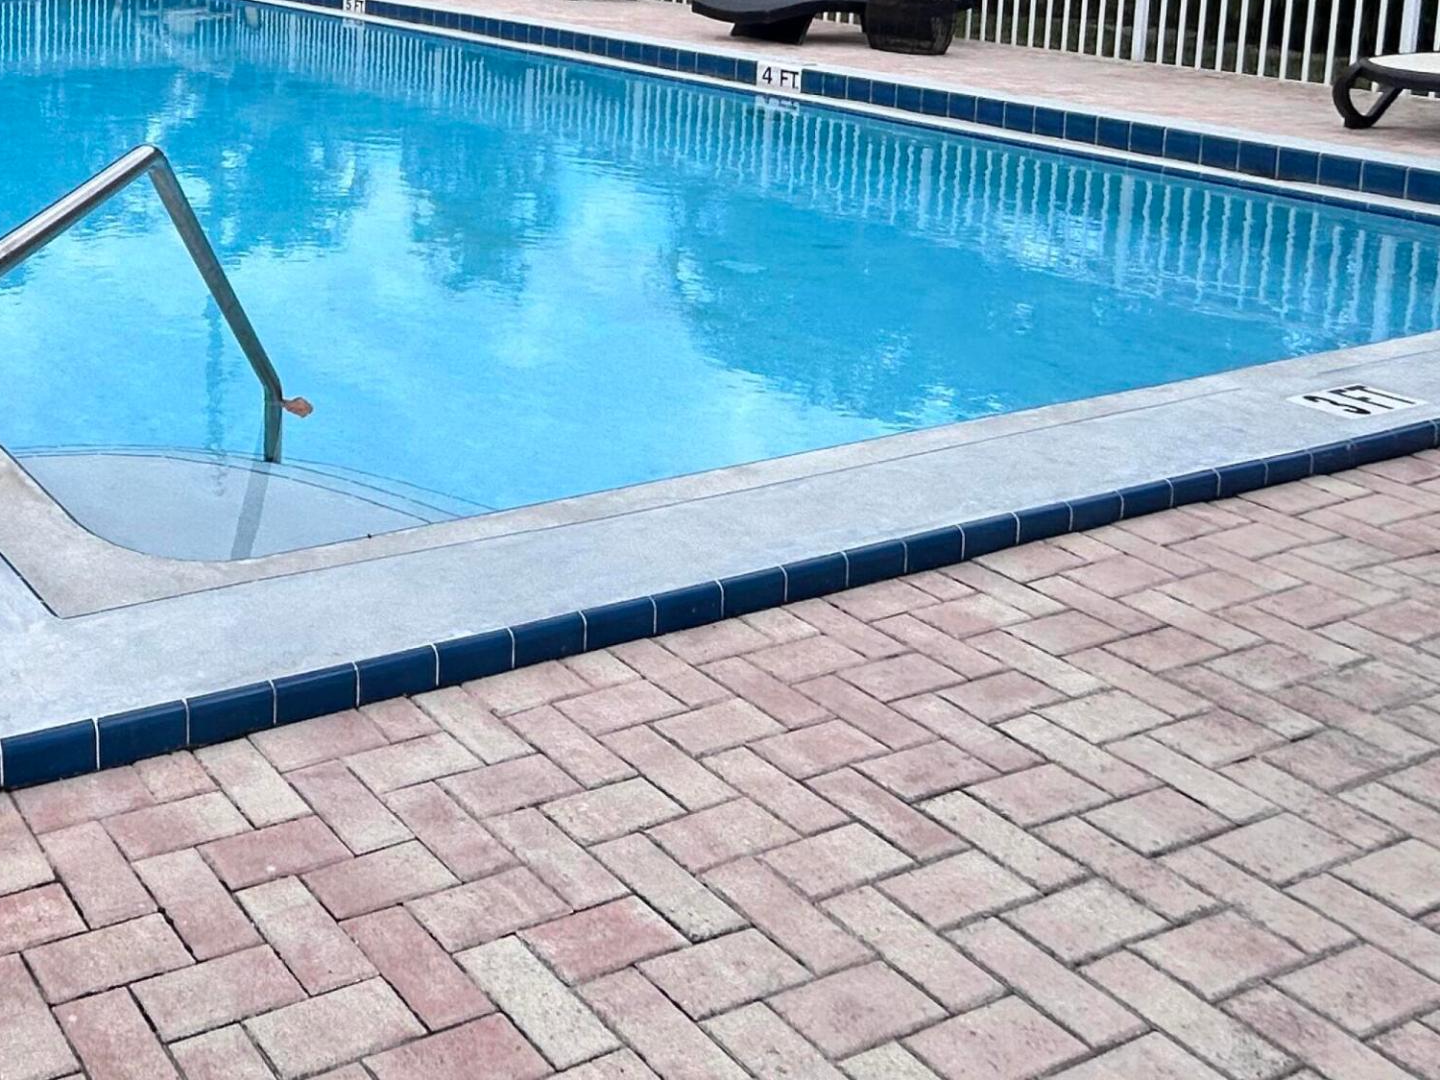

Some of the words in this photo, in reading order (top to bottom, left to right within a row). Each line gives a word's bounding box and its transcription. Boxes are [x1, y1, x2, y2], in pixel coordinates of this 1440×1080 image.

[762, 66, 772, 85] 4
[1302, 395, 1371, 415] 3
[1327, 384, 1416, 410] FT
